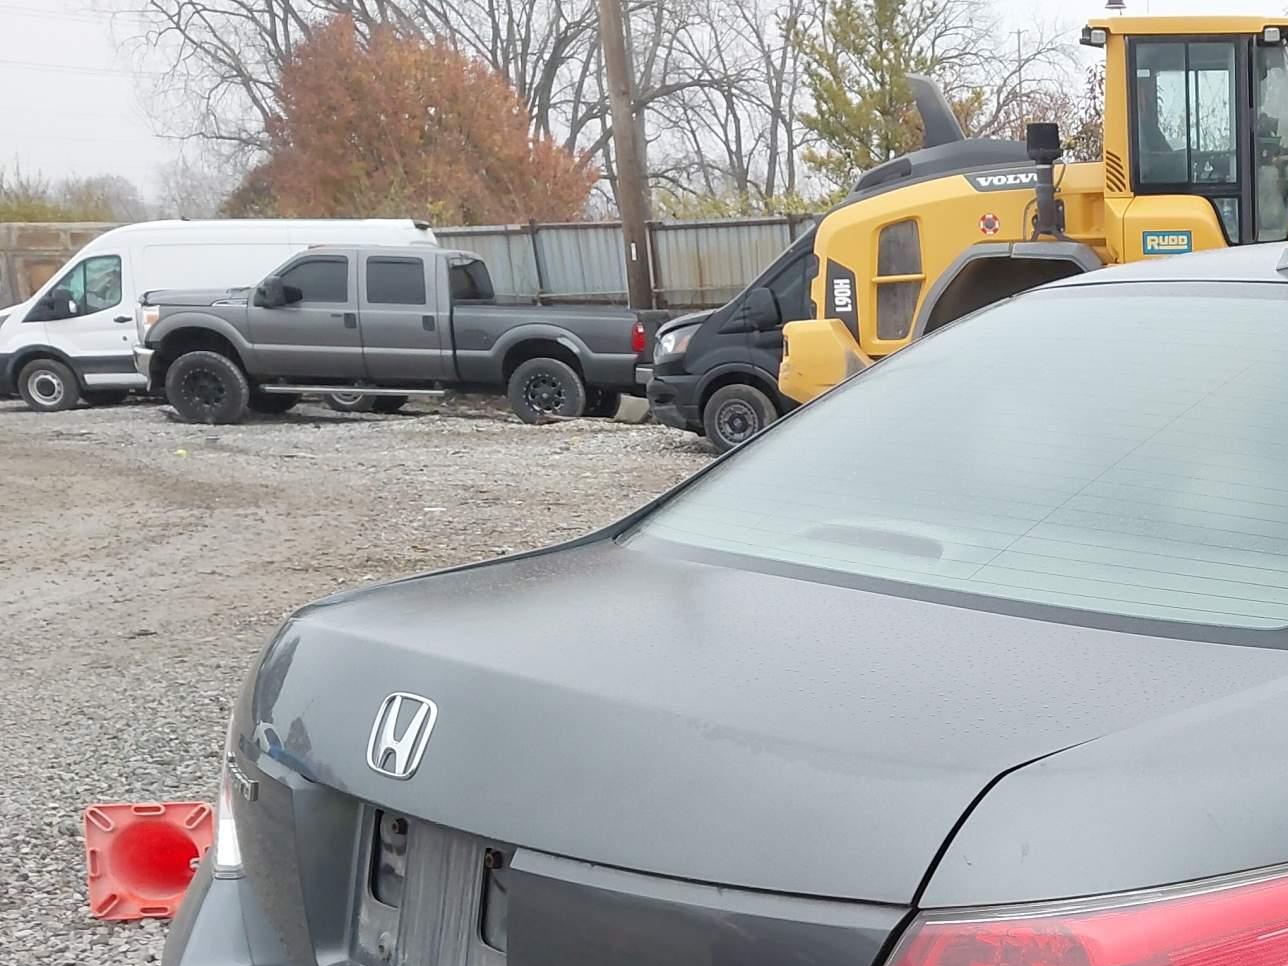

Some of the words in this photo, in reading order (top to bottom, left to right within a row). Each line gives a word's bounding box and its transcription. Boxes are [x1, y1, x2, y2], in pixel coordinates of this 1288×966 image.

[976, 173, 1038, 187] VOLV
[1146, 235, 1188, 250] RUDD
[833, 278, 852, 312] L90H
